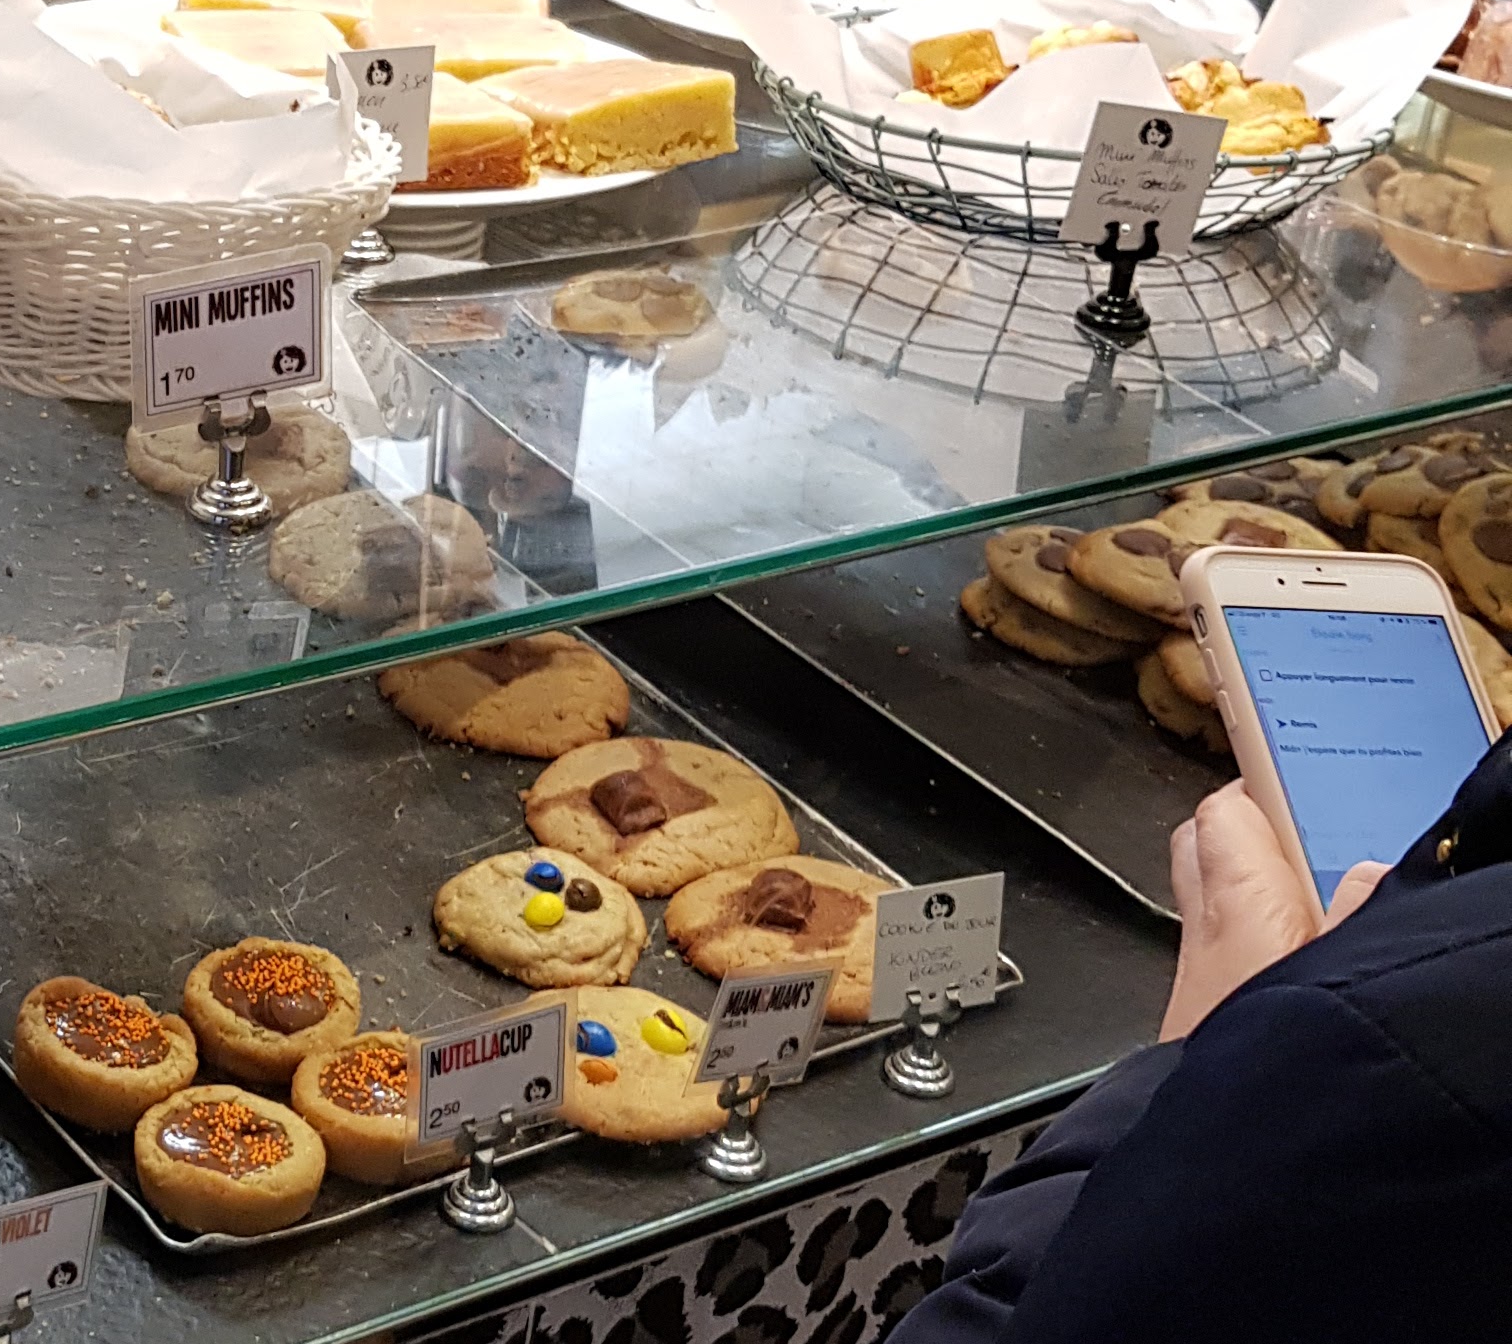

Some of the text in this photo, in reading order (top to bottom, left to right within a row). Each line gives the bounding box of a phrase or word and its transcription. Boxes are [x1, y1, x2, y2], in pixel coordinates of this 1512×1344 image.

[154, 277, 295, 337] MINI MUFFINS
[429, 1023, 533, 1078] NUTELLACUP
